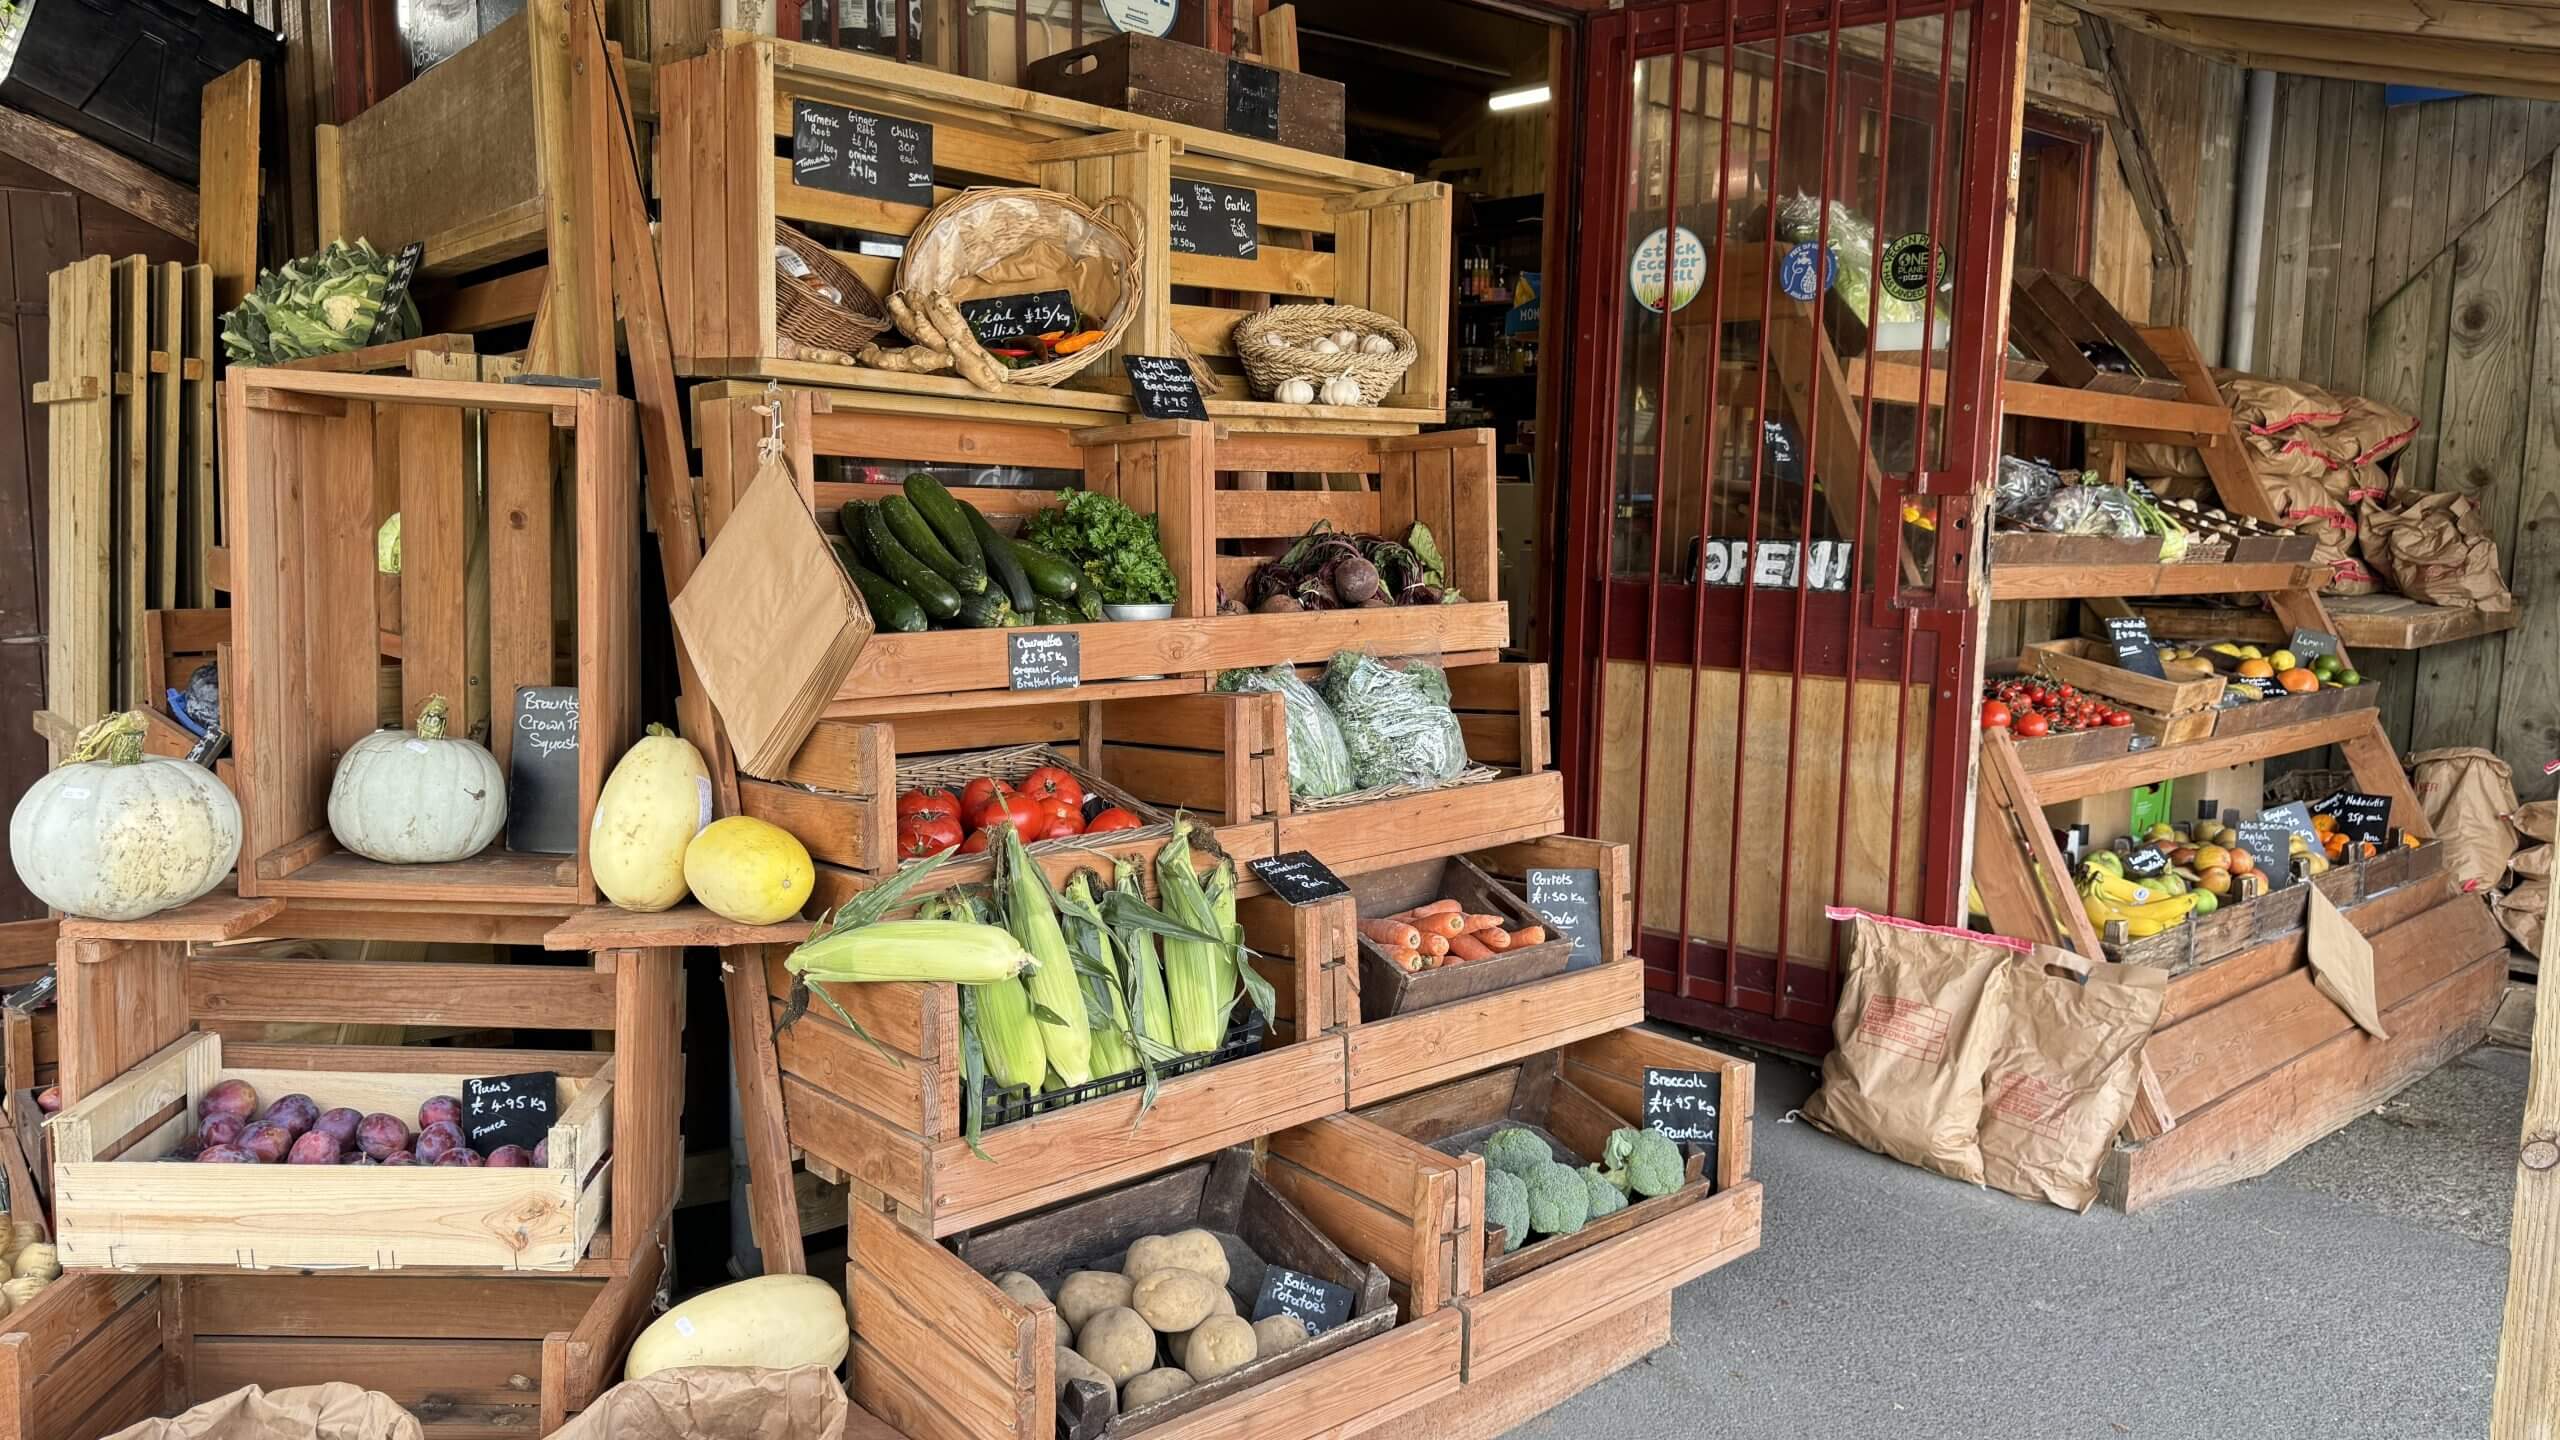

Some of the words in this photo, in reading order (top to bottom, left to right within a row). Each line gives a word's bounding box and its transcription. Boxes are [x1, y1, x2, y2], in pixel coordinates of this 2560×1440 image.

[800, 109, 840, 128] Turmeric
[848, 111, 878, 126] Ginger
[811, 125, 831, 136] Root
[856, 124, 876, 136] Root
[898, 140, 915, 156] 30p
[899, 153, 919, 165] each
[1224, 195, 1251, 213] Garlic
[1642, 243, 1697, 258] stck
[1884, 235, 1917, 263] VEGAN
[1898, 252, 1929, 266] ONE
[1898, 265, 1928, 274] PLANET
[1902, 274, 1923, 284] pizza
[518, 713, 566, 731] Crown
[2254, 842, 2275, 853] Cox
[1532, 871, 1573, 885] Carrots
[1531, 886, 1568, 904] £1.50
[1649, 1070, 1708, 1088] Broccoli
[530, 1097, 547, 1112] Kg
[1648, 1089, 1696, 1114] £4.95
[472, 1119, 508, 1140] France
[1652, 1119, 1714, 1141] Braunton
[1283, 1271, 1325, 1302] Baking
[1272, 1282, 1326, 1314] Potatoes
